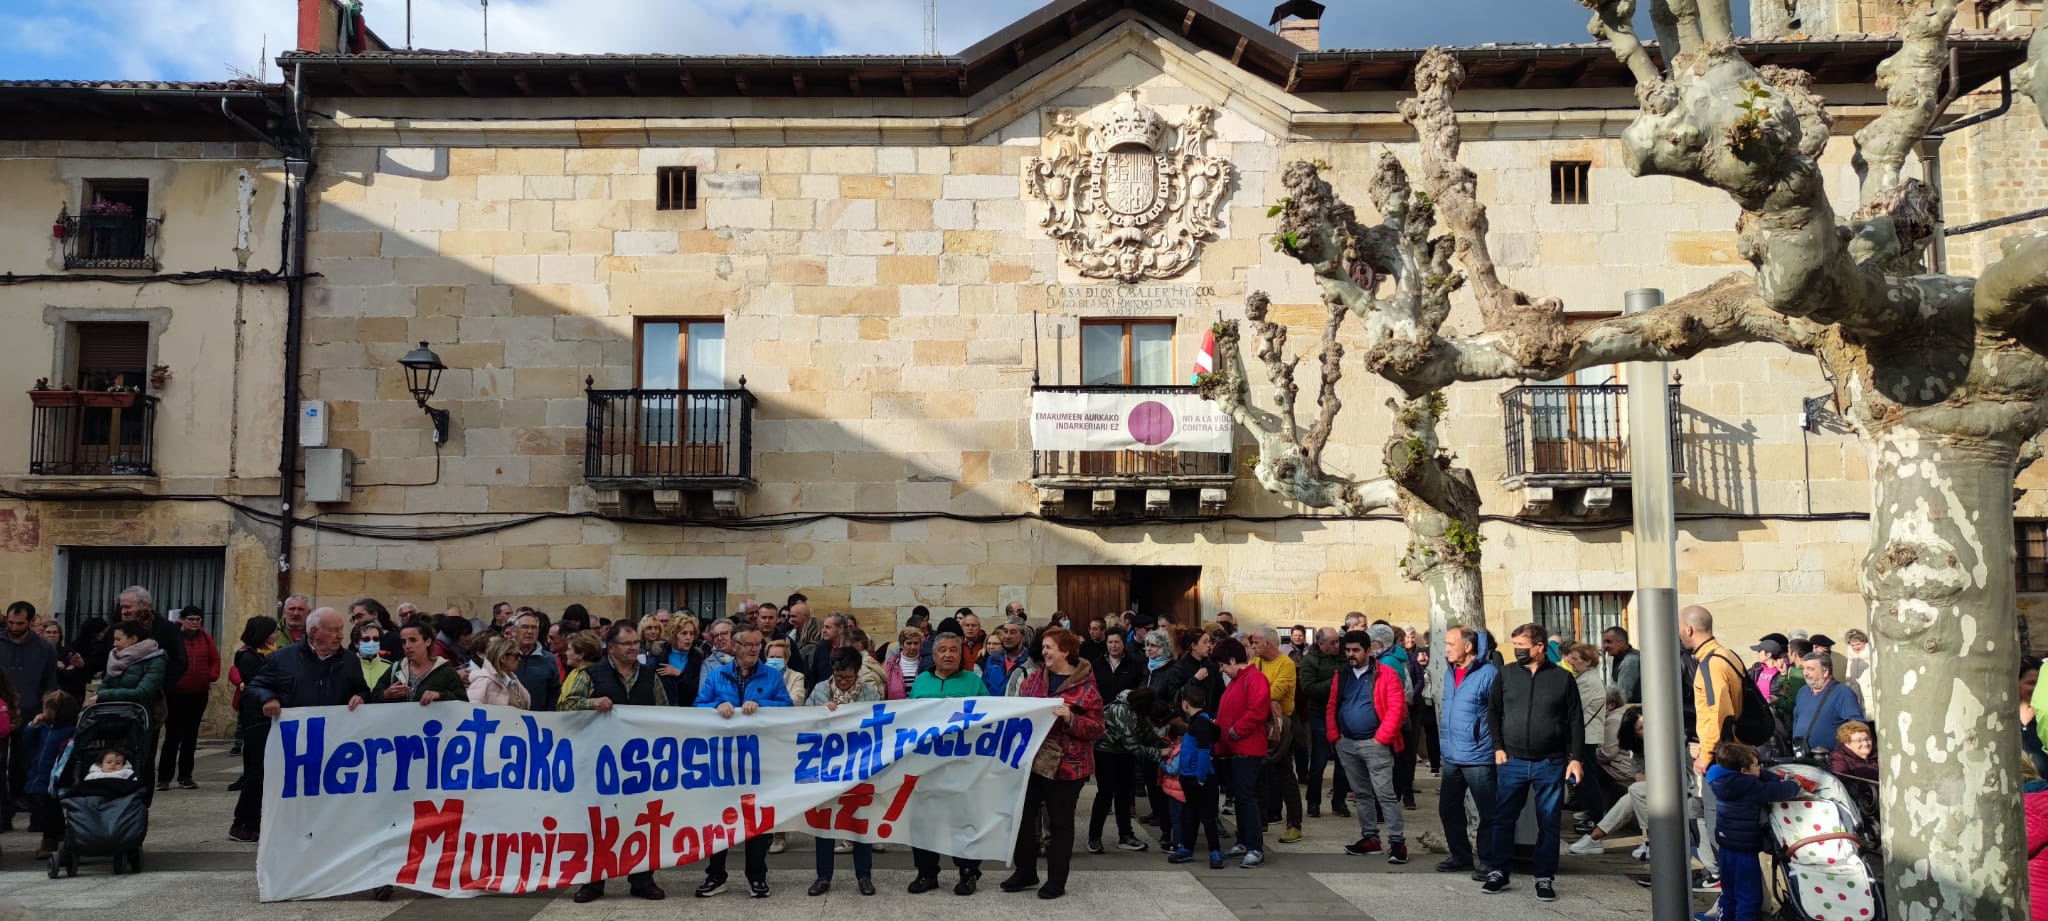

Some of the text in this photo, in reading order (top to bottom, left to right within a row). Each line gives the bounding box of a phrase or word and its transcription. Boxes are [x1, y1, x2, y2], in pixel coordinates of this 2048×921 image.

[1035, 412, 1120, 422] EMAKUMEEN AURKAKO
[1182, 415, 1193, 423] NO
[1195, 415, 1201, 423] A
[1202, 415, 1212, 423] LA
[1056, 422, 1120, 431] INDARKERIARI EZ
[1182, 423, 1213, 432] CONTRA
[1214, 423, 1229, 432] LAS
[280, 708, 575, 798] Herrietako
[596, 733, 760, 795] osasun
